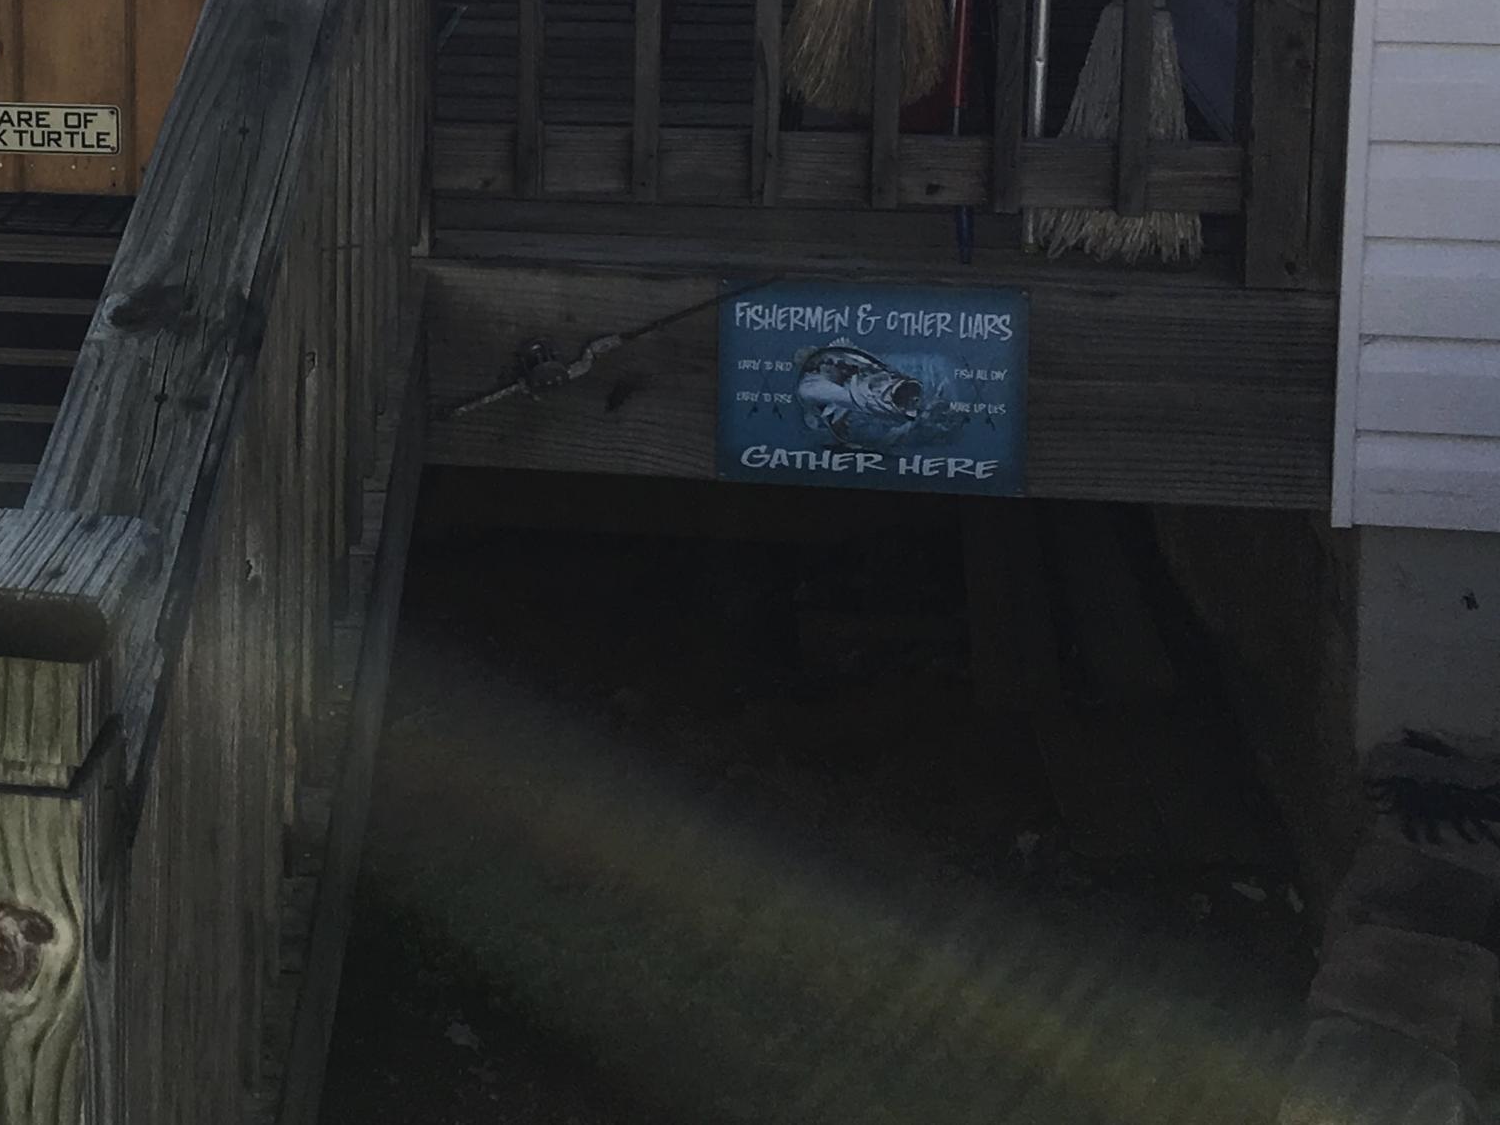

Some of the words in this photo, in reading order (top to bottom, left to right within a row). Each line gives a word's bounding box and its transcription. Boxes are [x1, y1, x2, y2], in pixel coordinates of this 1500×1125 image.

[63, 112, 98, 129] OF
[13, 130, 111, 149] TURTLE
[735, 302, 849, 333] FISHERMEN
[857, 304, 882, 335] &
[886, 310, 953, 338] OTHER
[959, 312, 1013, 341] LIARS
[740, 444, 887, 474] GATHER
[899, 455, 998, 479] HERE
